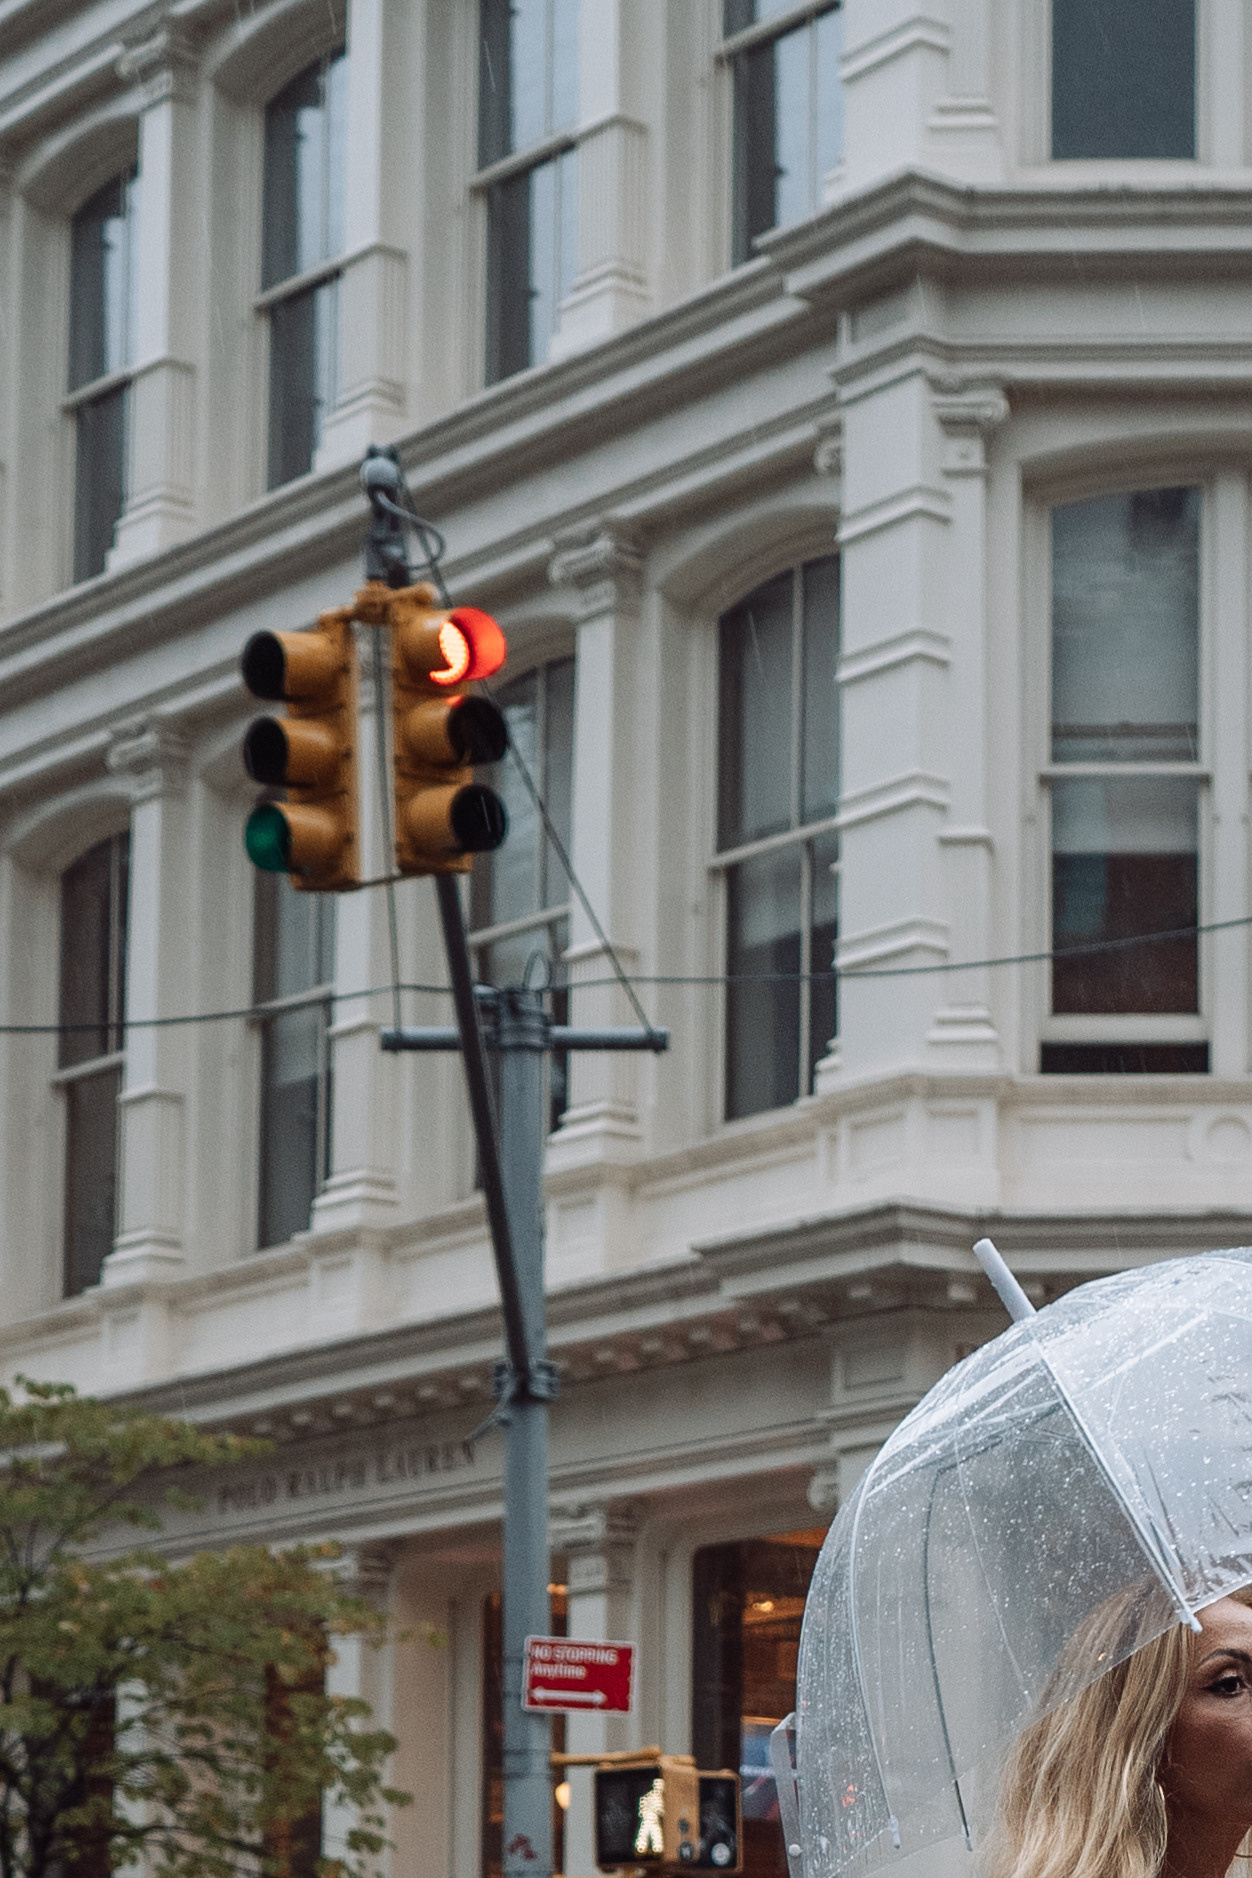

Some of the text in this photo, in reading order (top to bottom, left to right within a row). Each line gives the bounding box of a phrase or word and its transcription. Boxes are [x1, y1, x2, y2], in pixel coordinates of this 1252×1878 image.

[375, 1438, 475, 1486] LAUREN
[532, 1645, 619, 1664] NO STOPPING
[532, 1663, 587, 1679] Anytime
